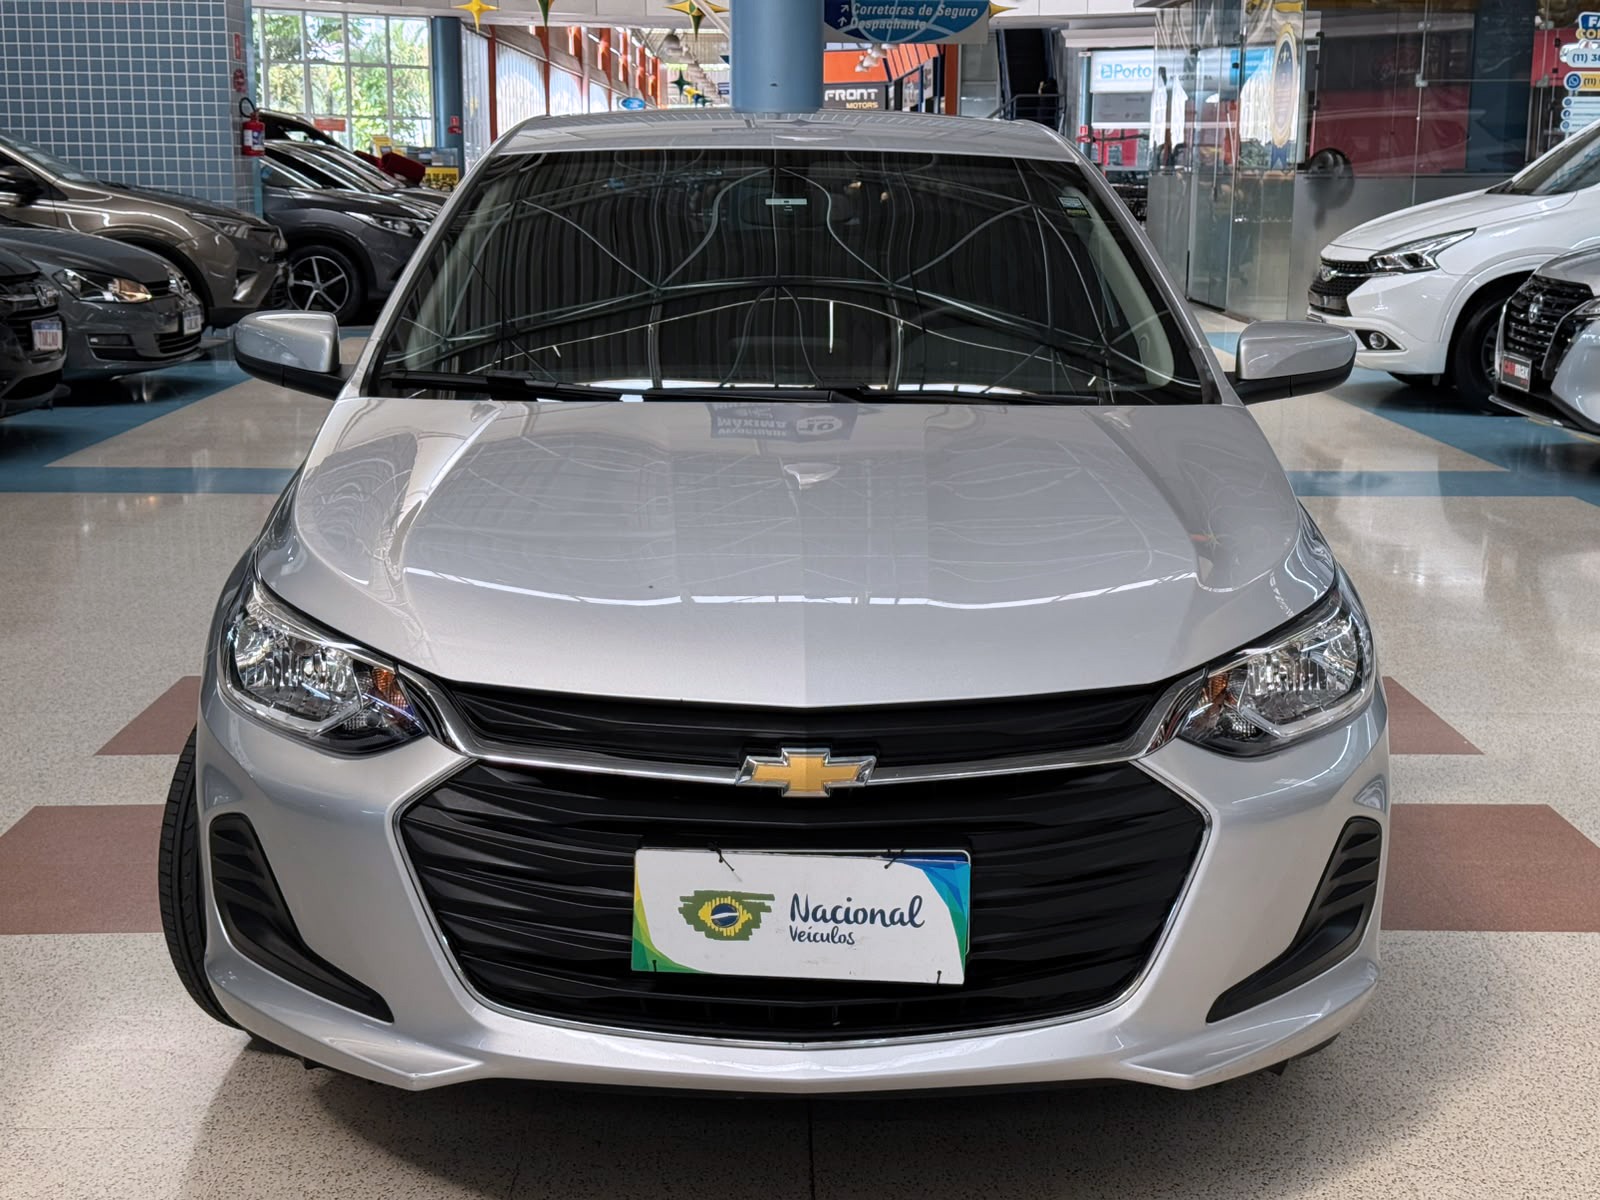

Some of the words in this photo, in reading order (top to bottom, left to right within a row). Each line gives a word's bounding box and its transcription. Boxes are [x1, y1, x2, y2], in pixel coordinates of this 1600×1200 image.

[852, 3, 914, 15] Corretoras
[918, 4, 933, 16] de
[936, 4, 979, 19] Seguro
[850, 17, 927, 31] Despachante
[1114, 63, 1152, 78] Porto
[824, 88, 879, 101] FRONT
[846, 101, 879, 109] MOTORS
[790, 893, 925, 928] Nacional
[789, 924, 855, 945] Veículos
